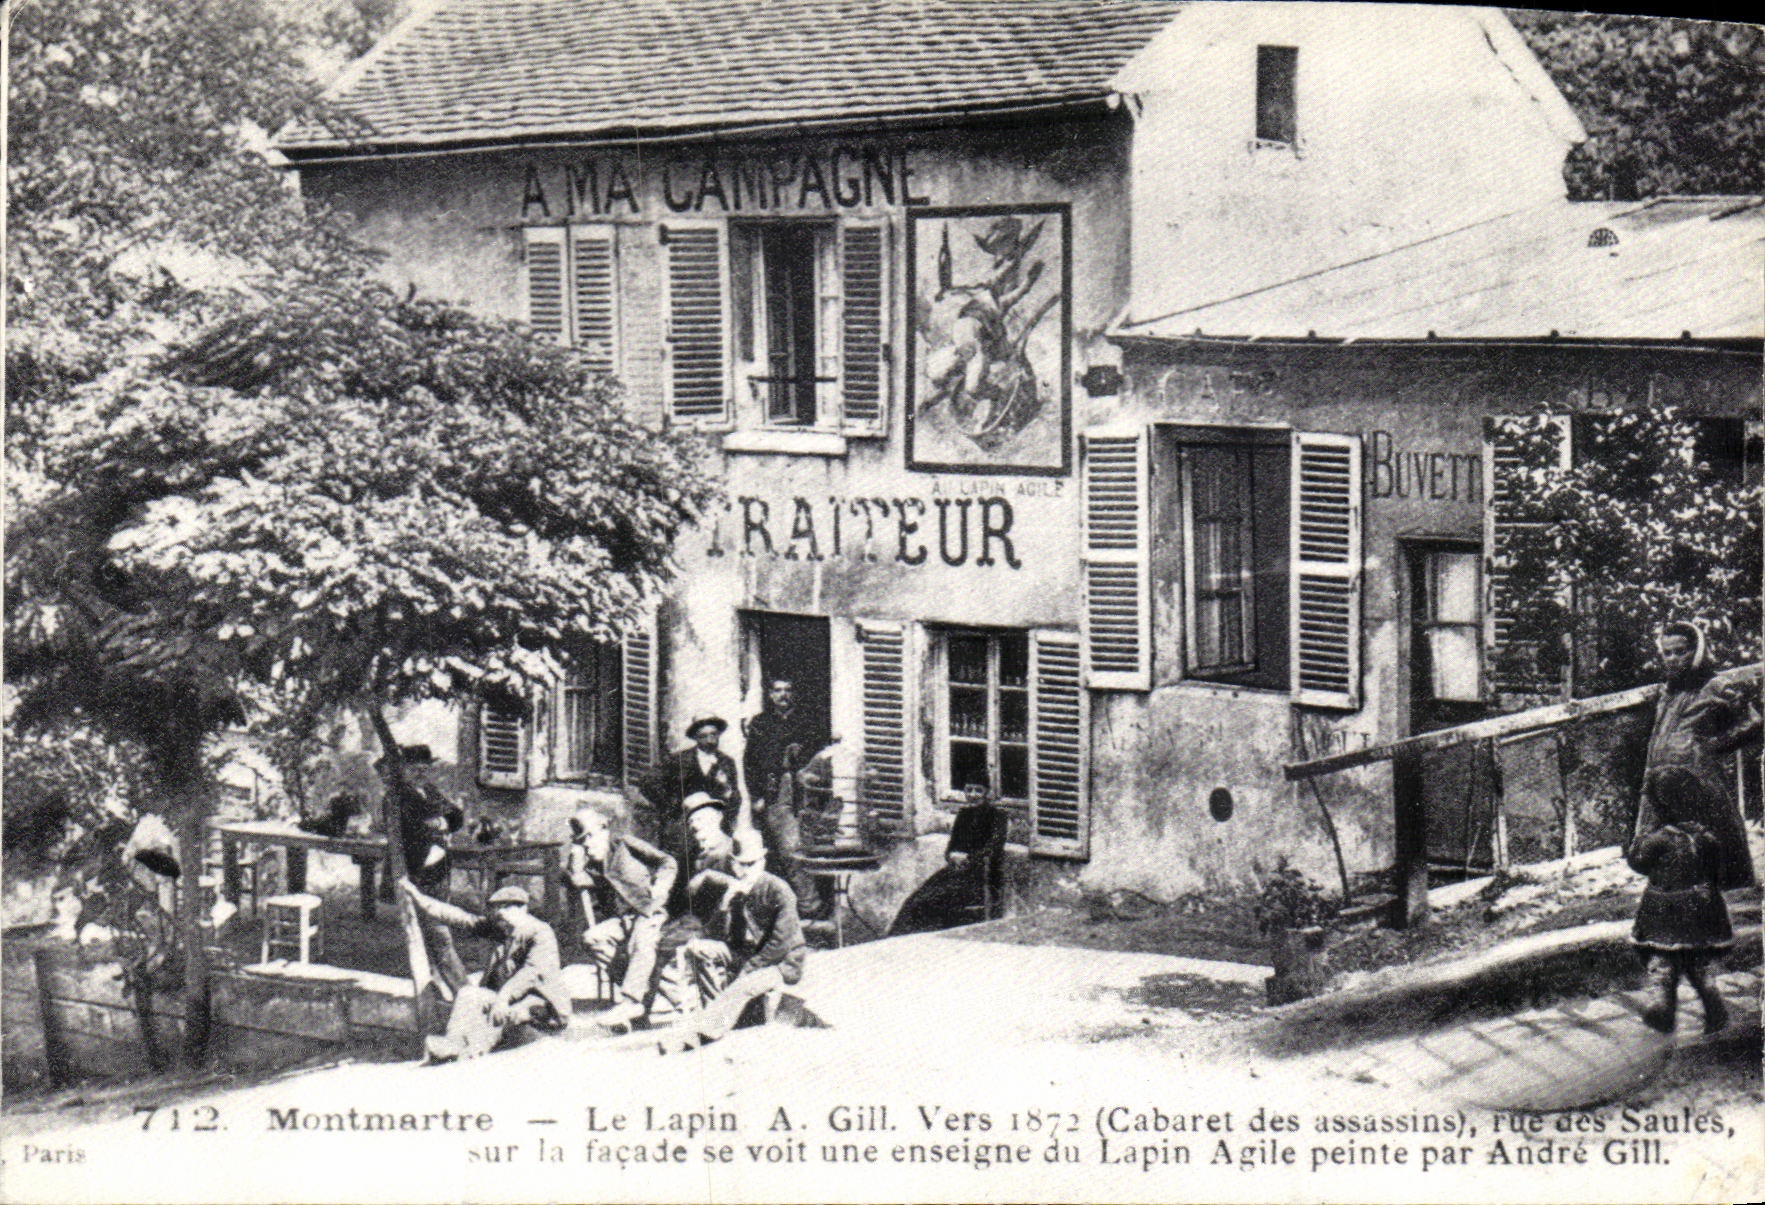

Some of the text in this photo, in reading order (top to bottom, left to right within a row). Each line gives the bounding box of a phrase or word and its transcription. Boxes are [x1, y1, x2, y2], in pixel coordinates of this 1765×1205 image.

[521, 144, 931, 217] A MA CAMPAGNE
[960, 481, 1006, 496] LAPIN
[1016, 480, 1065, 498] AGILE
